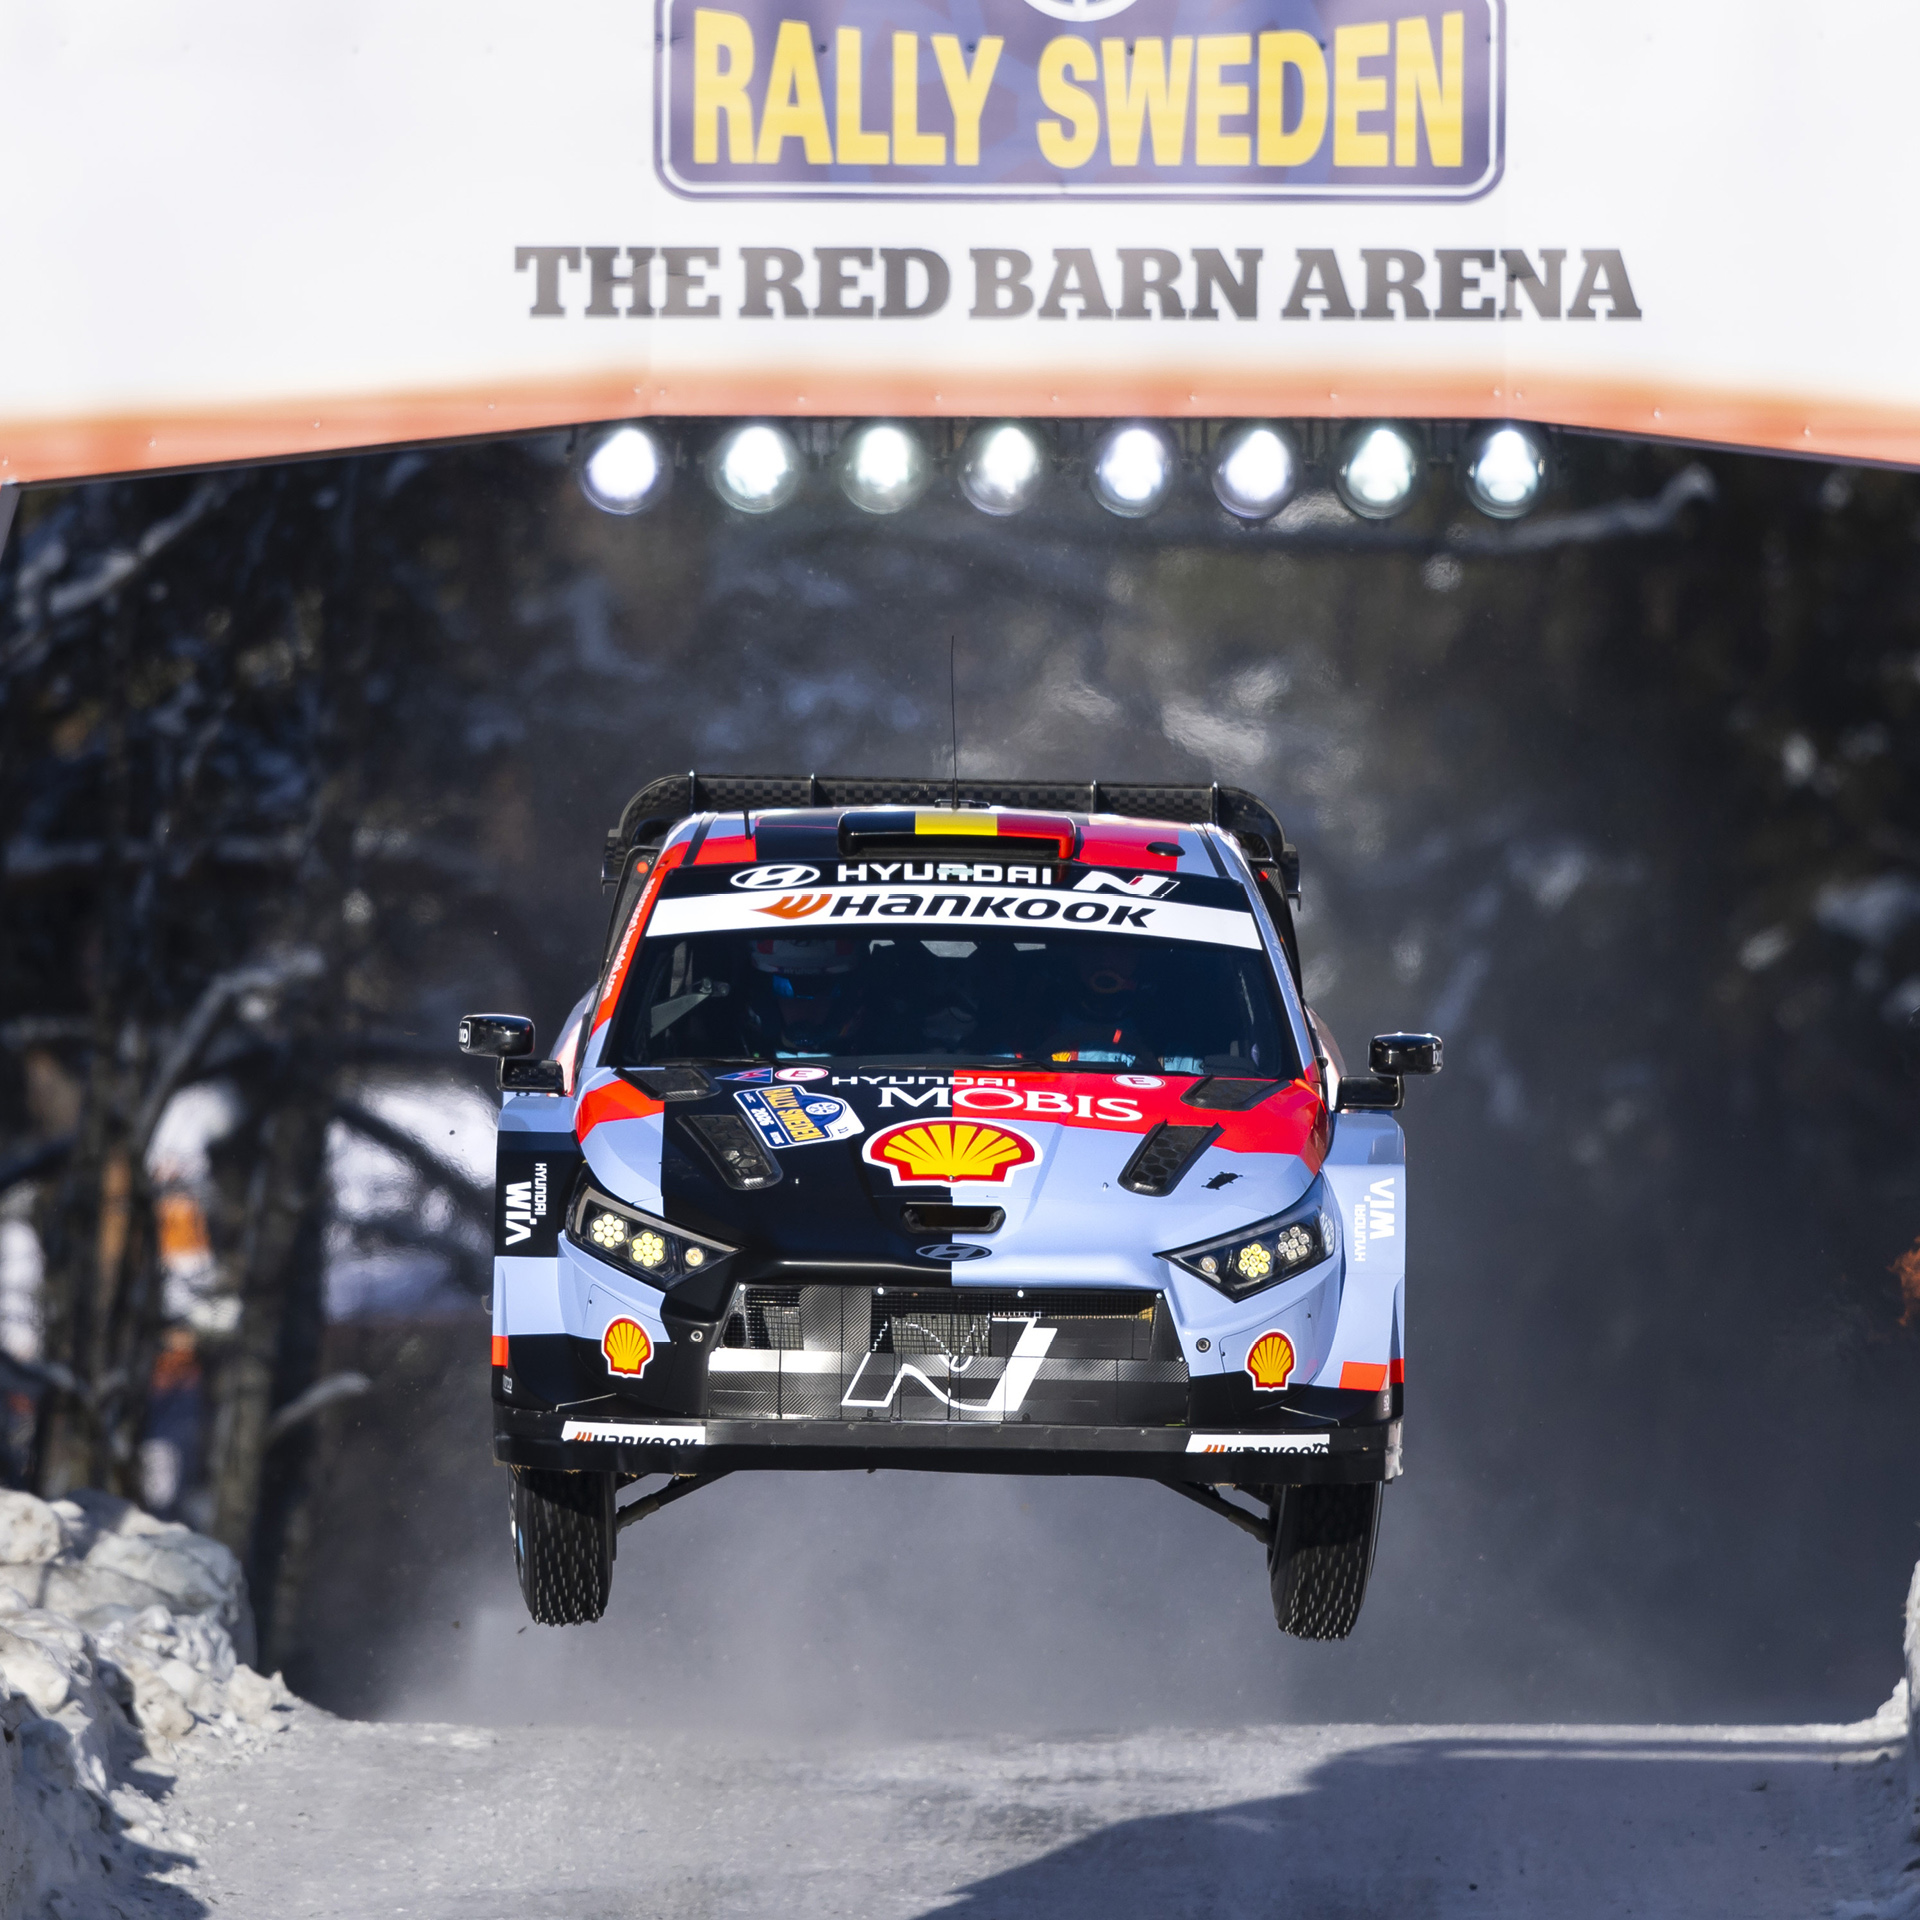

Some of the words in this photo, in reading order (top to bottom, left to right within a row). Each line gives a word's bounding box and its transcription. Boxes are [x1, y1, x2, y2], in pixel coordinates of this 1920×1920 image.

[693, 8, 1002, 166] RALLY
[1038, 9, 1464, 168] SWEDEN
[515, 246, 720, 318] THE
[739, 247, 951, 318] RED
[969, 247, 1263, 320] BARN
[1280, 247, 1642, 320] ARENA
[837, 863, 1051, 885] HYUNDAI
[762, 1087, 800, 1108] RALLY
[832, 1076, 1015, 1087] HYUNDAI
[878, 1087, 1143, 1121] MOBIS
[777, 1108, 826, 1141] SWEDEN
[534, 1163, 547, 1215] HYUNDAI
[1354, 1204, 1366, 1262] HYUNDAI
